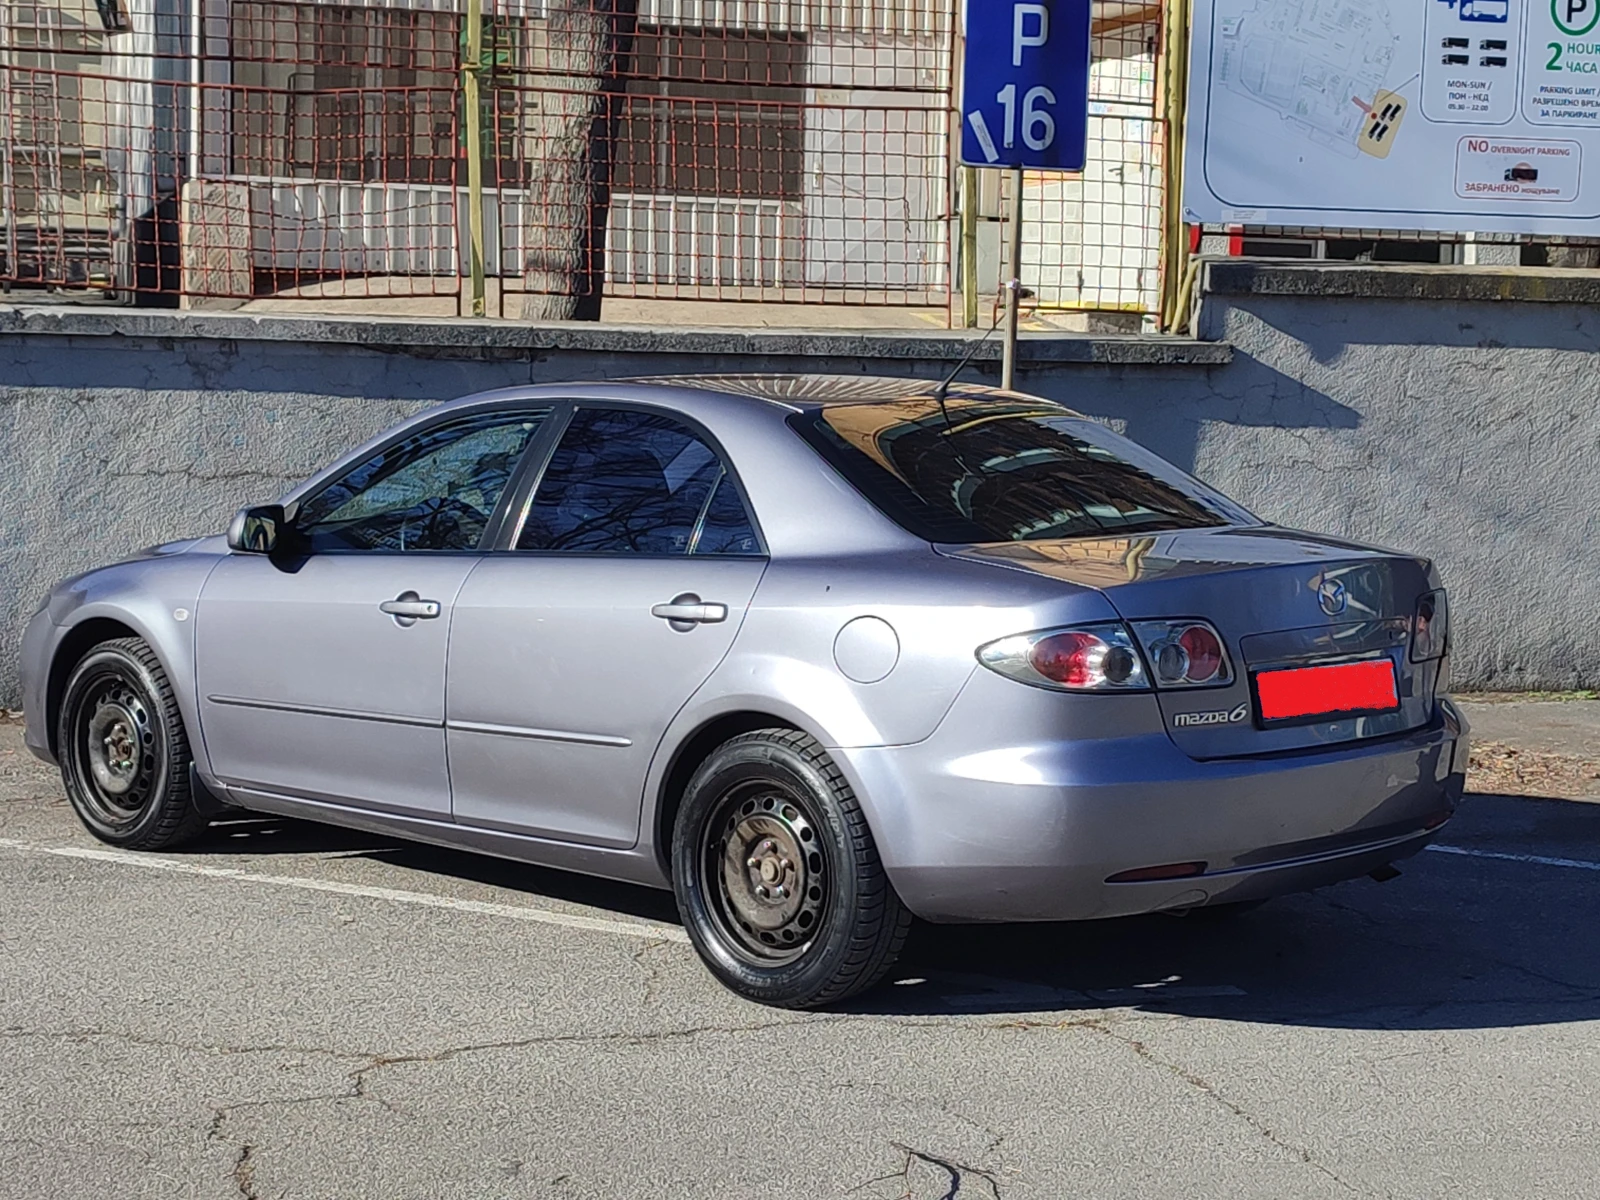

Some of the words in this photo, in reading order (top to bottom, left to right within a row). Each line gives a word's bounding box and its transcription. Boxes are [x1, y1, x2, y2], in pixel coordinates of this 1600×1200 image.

[1012, 3, 1049, 67] P
[1545, 42, 1563, 71] 2
[1565, 61, 1598, 74] ЧАСА
[1447, 80, 1486, 89] MON-SUN
[1539, 86, 1574, 95] PARKING
[1574, 88, 1596, 96] LIMIT
[1449, 92, 1466, 100] ПОН
[996, 84, 1057, 151] 16
[1467, 140, 1489, 153] NO
[1490, 146, 1535, 154] OVERNIGHT
[1537, 147, 1570, 156] PARKING
[1465, 182, 1519, 193] ЗАБРАНЕНО
